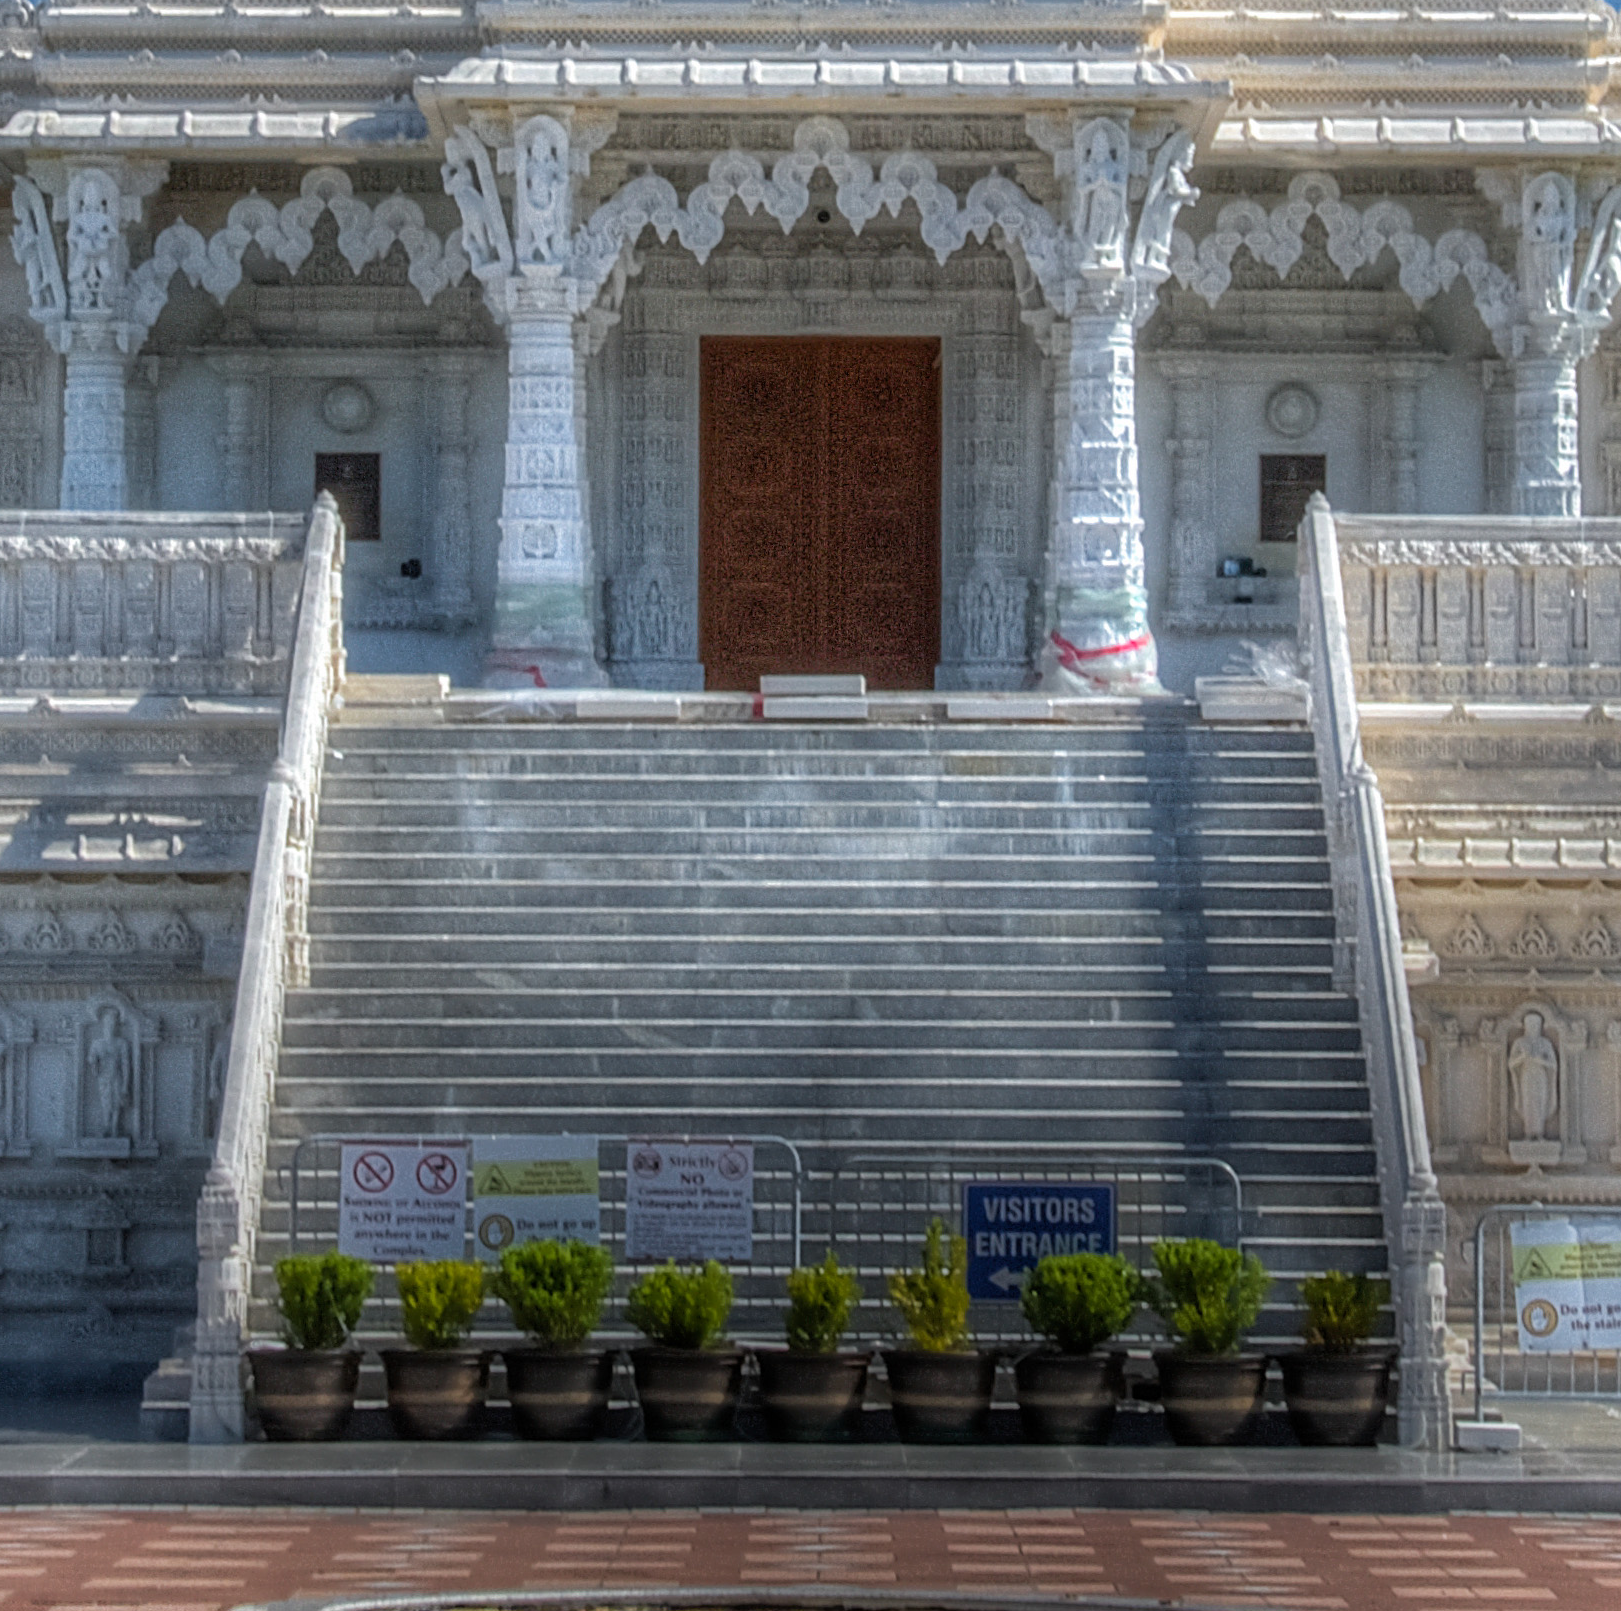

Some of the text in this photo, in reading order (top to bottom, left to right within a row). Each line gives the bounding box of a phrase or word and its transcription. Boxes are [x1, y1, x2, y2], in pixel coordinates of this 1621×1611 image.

[669, 1156, 715, 1168] Strictly
[681, 1173, 705, 1185] NO
[983, 1197, 1095, 1224] VISITORS
[363, 1213, 391, 1223] NOT
[397, 1214, 455, 1225] permitted
[517, 1219, 596, 1230] Do not go up
[355, 1229, 450, 1240] anywhere in the
[975, 1232, 1102, 1257] ENTRANCE
[1560, 1304, 1578, 1315] Do
[1582, 1304, 1602, 1314] not
[1606, 1305, 1621, 1315] go
[1571, 1320, 1590, 1331] the
